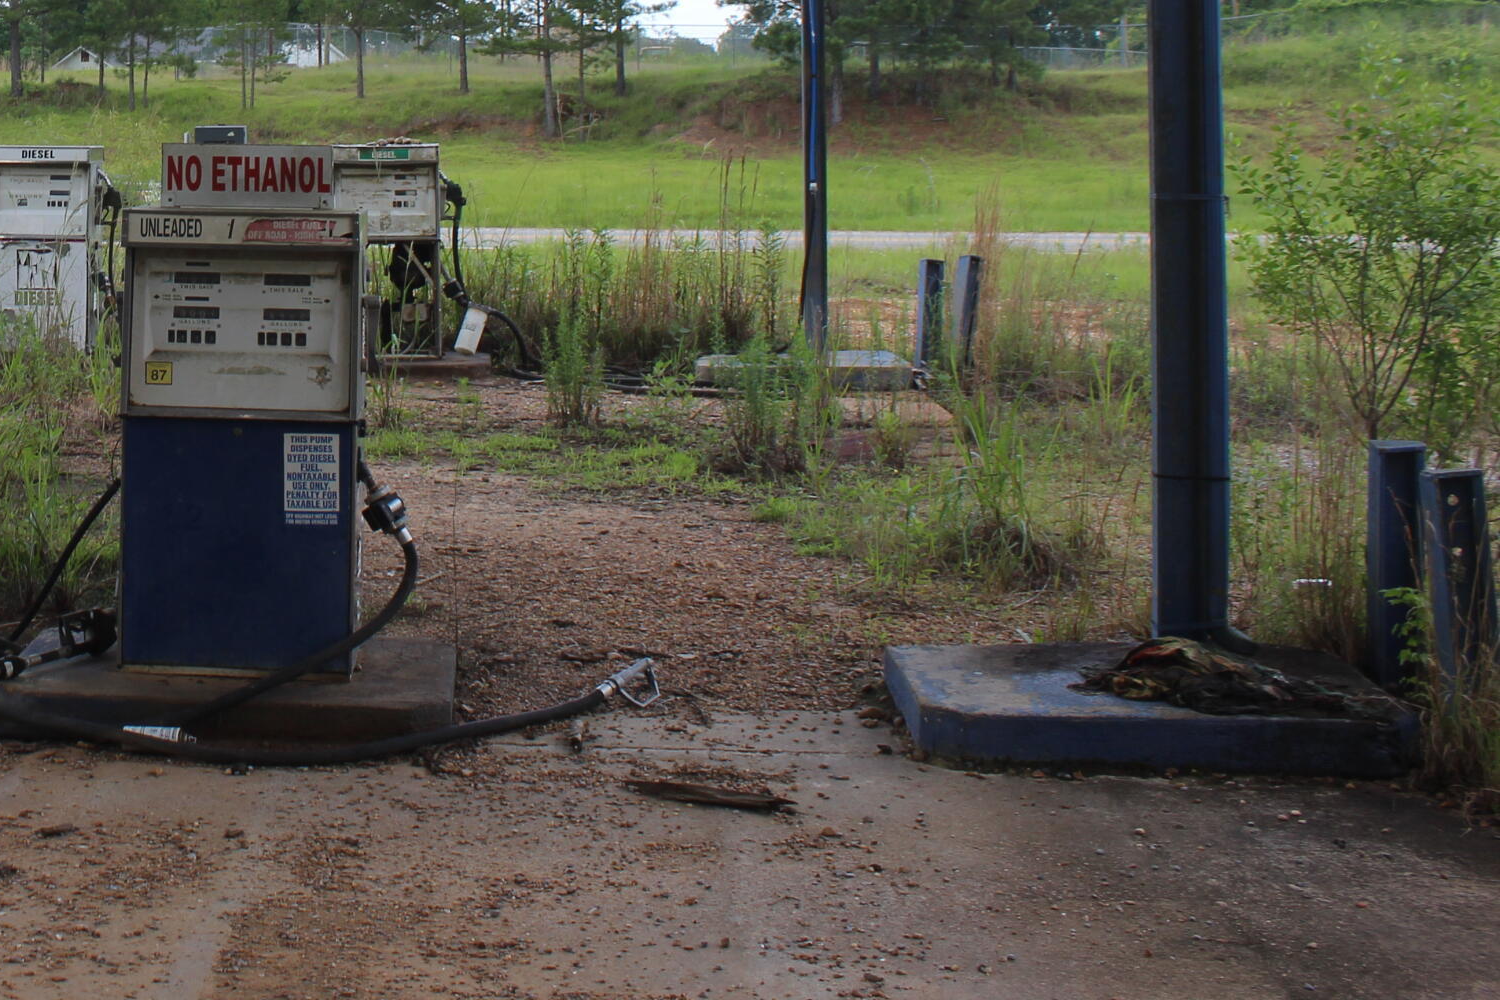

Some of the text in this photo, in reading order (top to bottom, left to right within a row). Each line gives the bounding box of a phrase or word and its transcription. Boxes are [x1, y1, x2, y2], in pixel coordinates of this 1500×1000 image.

[21, 149, 55, 159] DIESEL
[166, 155, 331, 194] NO ETHANOL
[140, 218, 203, 239] UNLEADED
[151, 368, 167, 381] 87
[291, 435, 308, 443] THIS
[290, 445, 333, 453] DISPENSES
[287, 454, 336, 463] DYED DIESEL
[300, 463, 322, 472] FUEL.
[286, 472, 337, 481] NONTAXABLE
[292, 481, 331, 490] USE ONLY.
[286, 490, 337, 499] PENALTY FOR
[286, 500, 337, 508] TAXABLE USE
